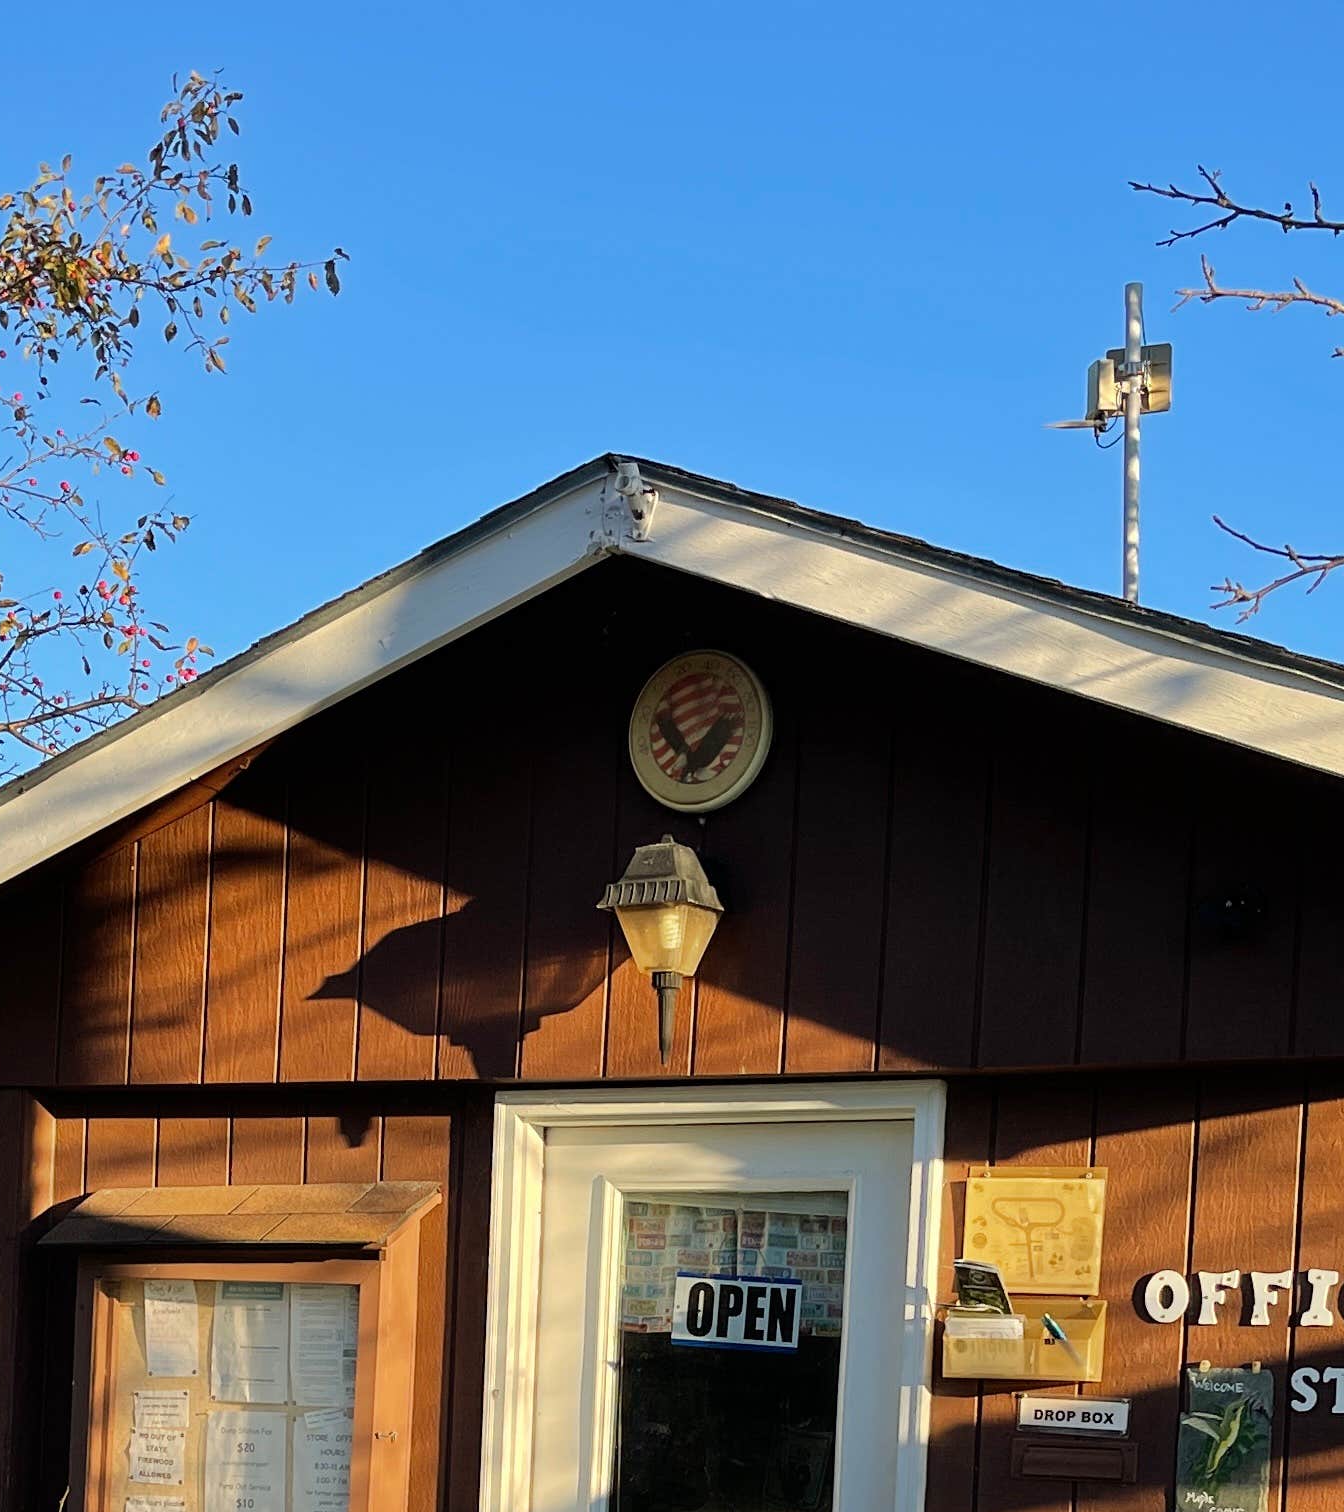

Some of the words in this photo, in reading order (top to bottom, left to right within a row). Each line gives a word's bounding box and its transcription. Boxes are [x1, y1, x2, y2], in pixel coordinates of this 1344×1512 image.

[686, 1281, 796, 1344] OPEN
[1034, 1409, 1076, 1422] DROP
[1081, 1412, 1114, 1425] BOX
[237, 1442, 255, 1453] $20
[236, 1499, 255, 1509] $10
[1185, 1491, 1214, 1509] Maple
